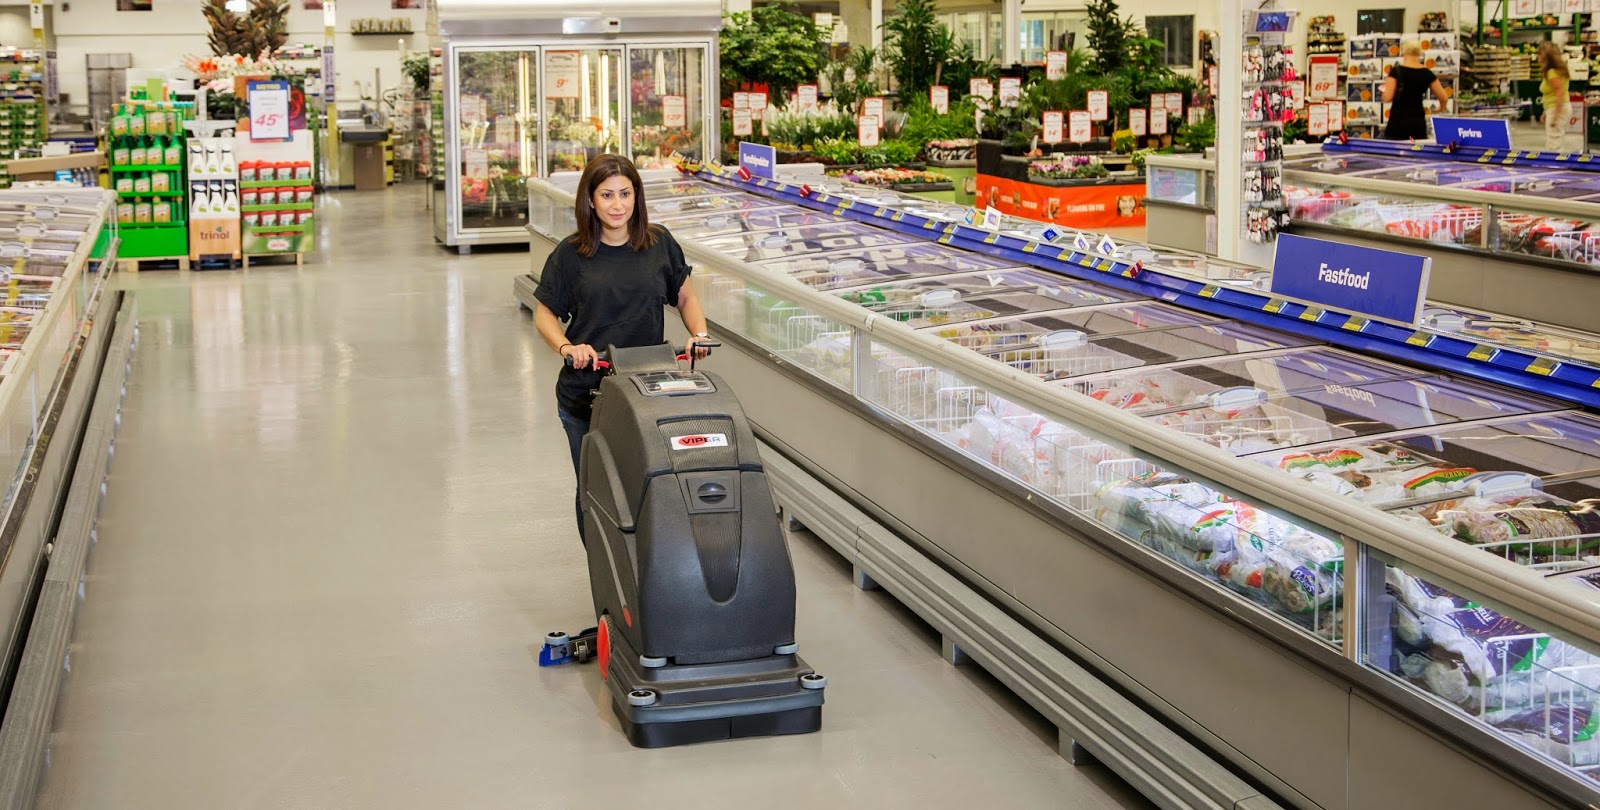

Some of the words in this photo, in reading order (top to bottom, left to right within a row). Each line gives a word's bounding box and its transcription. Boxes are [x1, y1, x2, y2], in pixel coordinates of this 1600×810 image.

[1315, 82, 1330, 91] 69
[200, 231, 230, 240] trinol
[1318, 262, 1370, 290] Fastfood
[681, 436, 721, 444] VIPER
